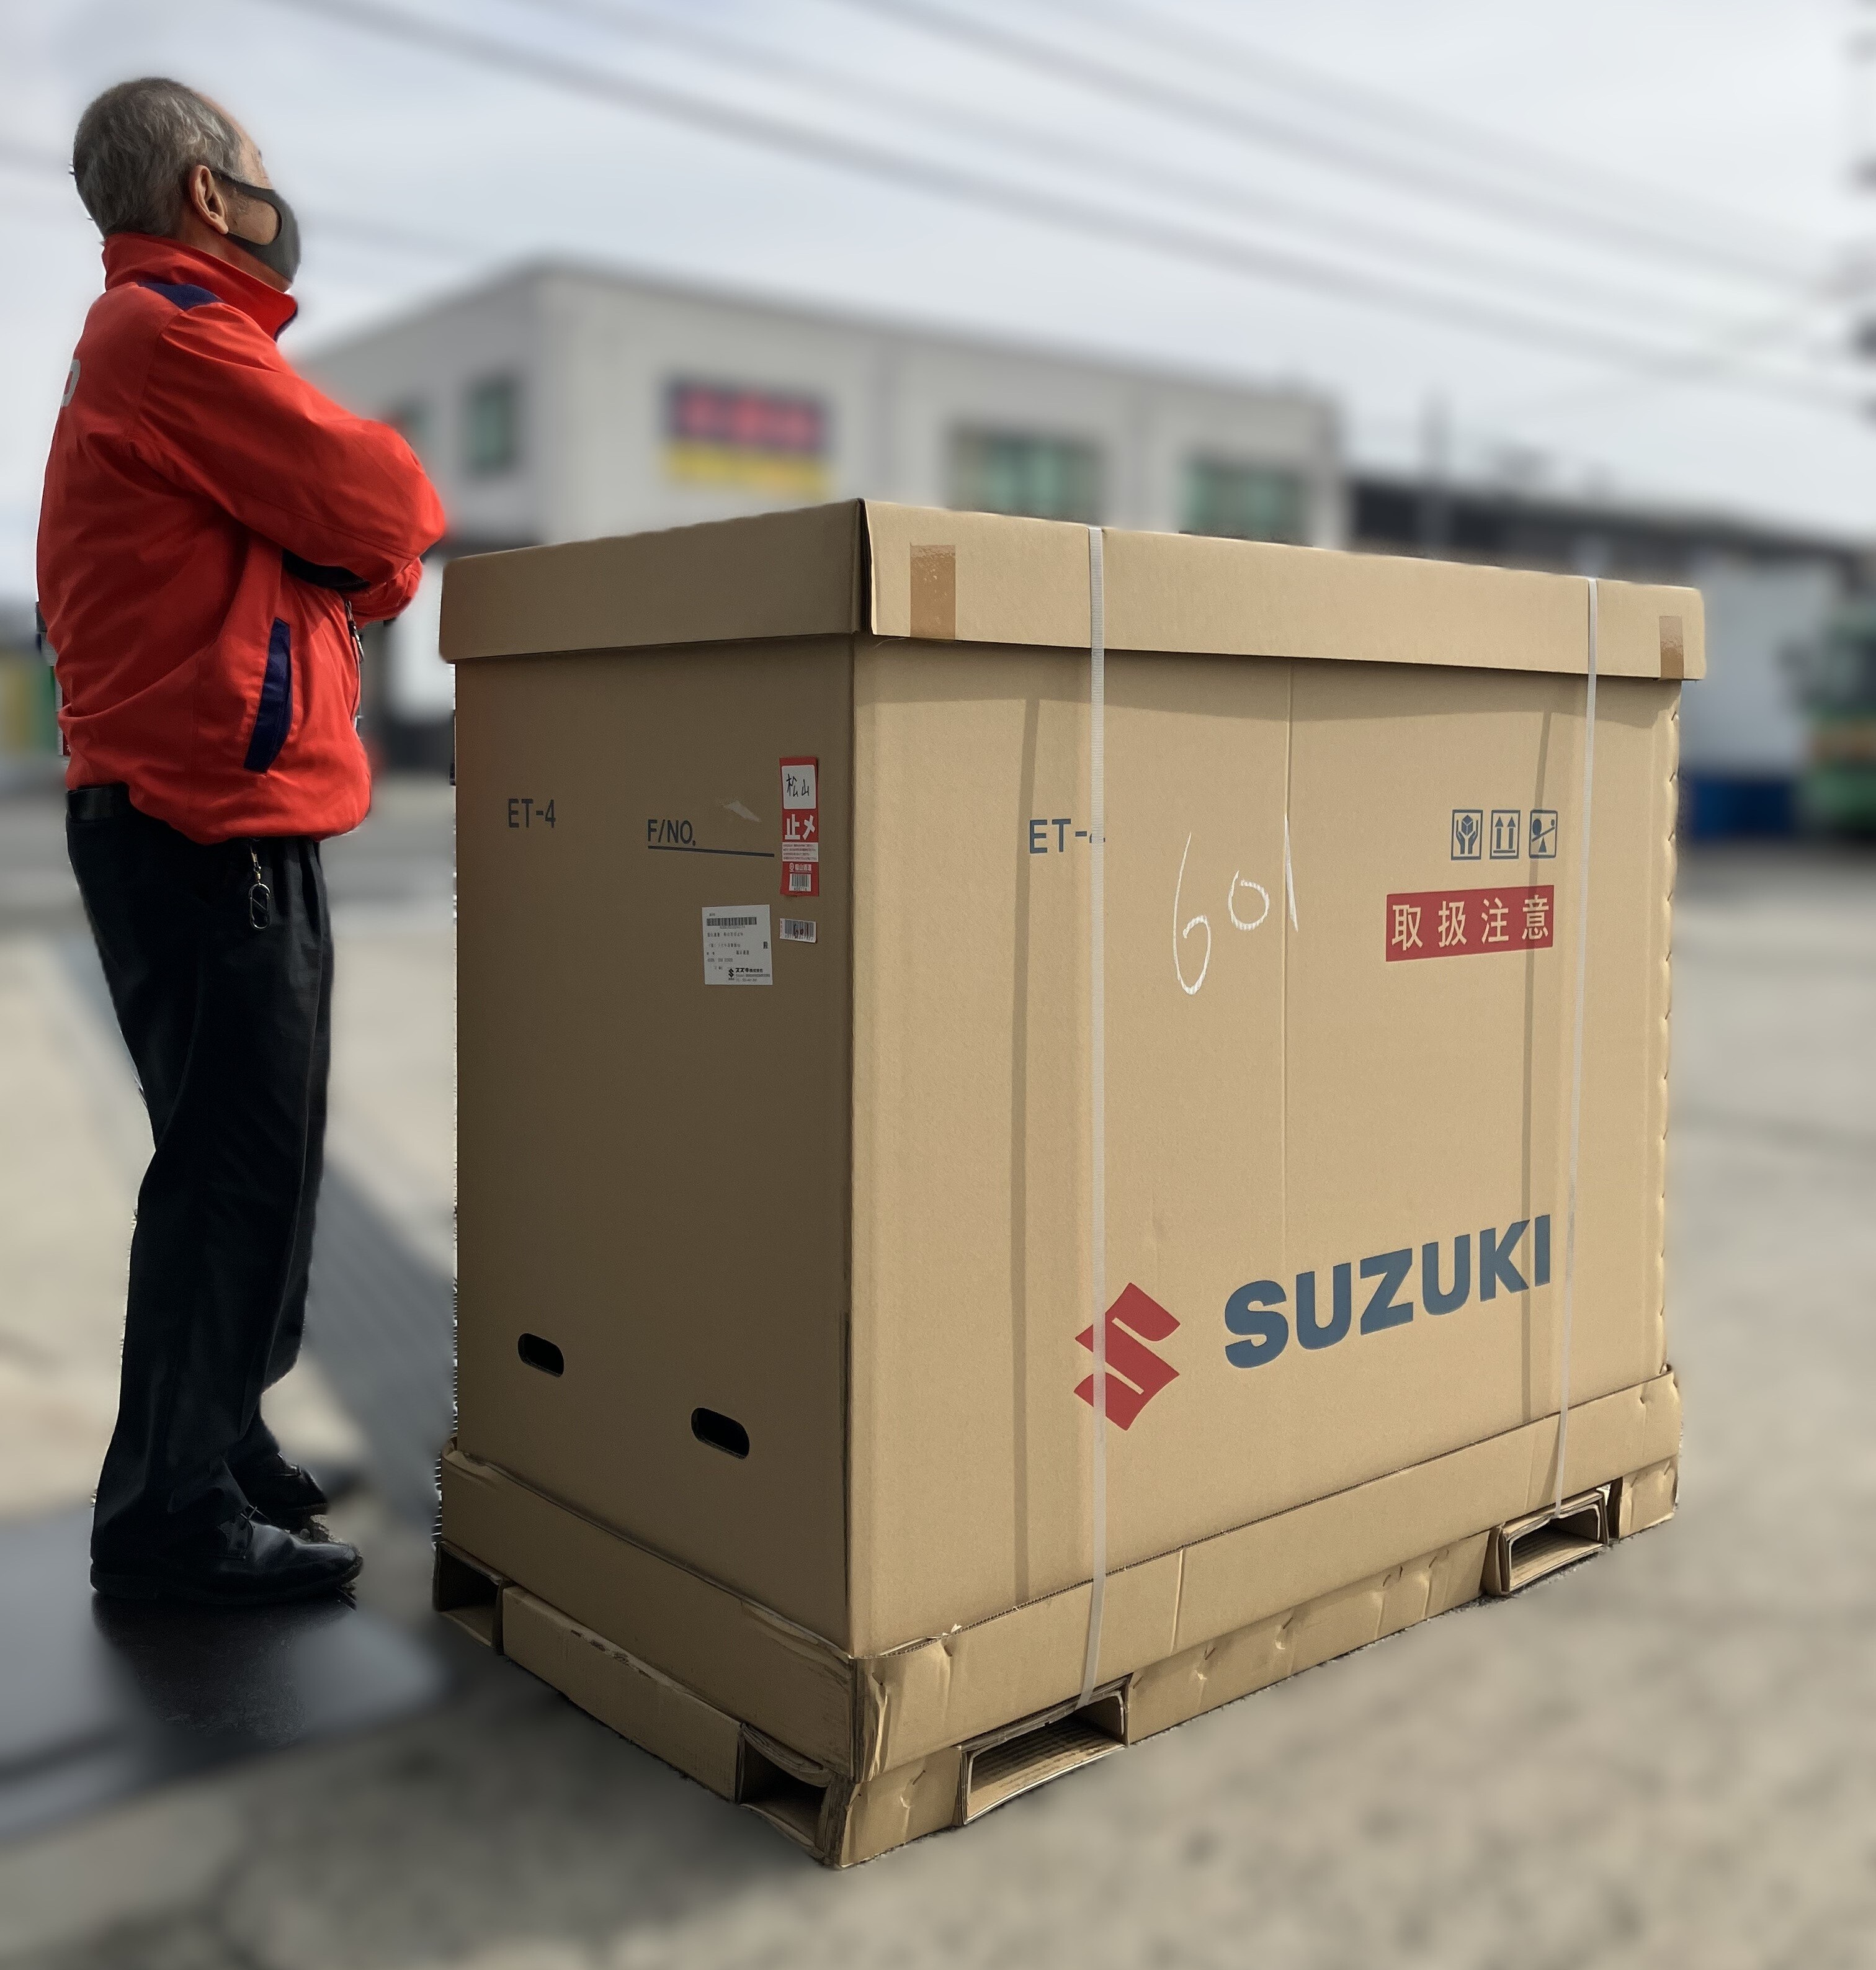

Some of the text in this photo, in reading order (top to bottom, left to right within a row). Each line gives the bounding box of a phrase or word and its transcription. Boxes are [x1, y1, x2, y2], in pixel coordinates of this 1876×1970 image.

[785, 773, 810, 797] 松山
[507, 798, 556, 828] ET-4
[647, 818, 696, 846] F/NO.
[1391, 893, 1550, 951] 取扱注意
[1224, 1214, 1550, 1369] SUZUKI
